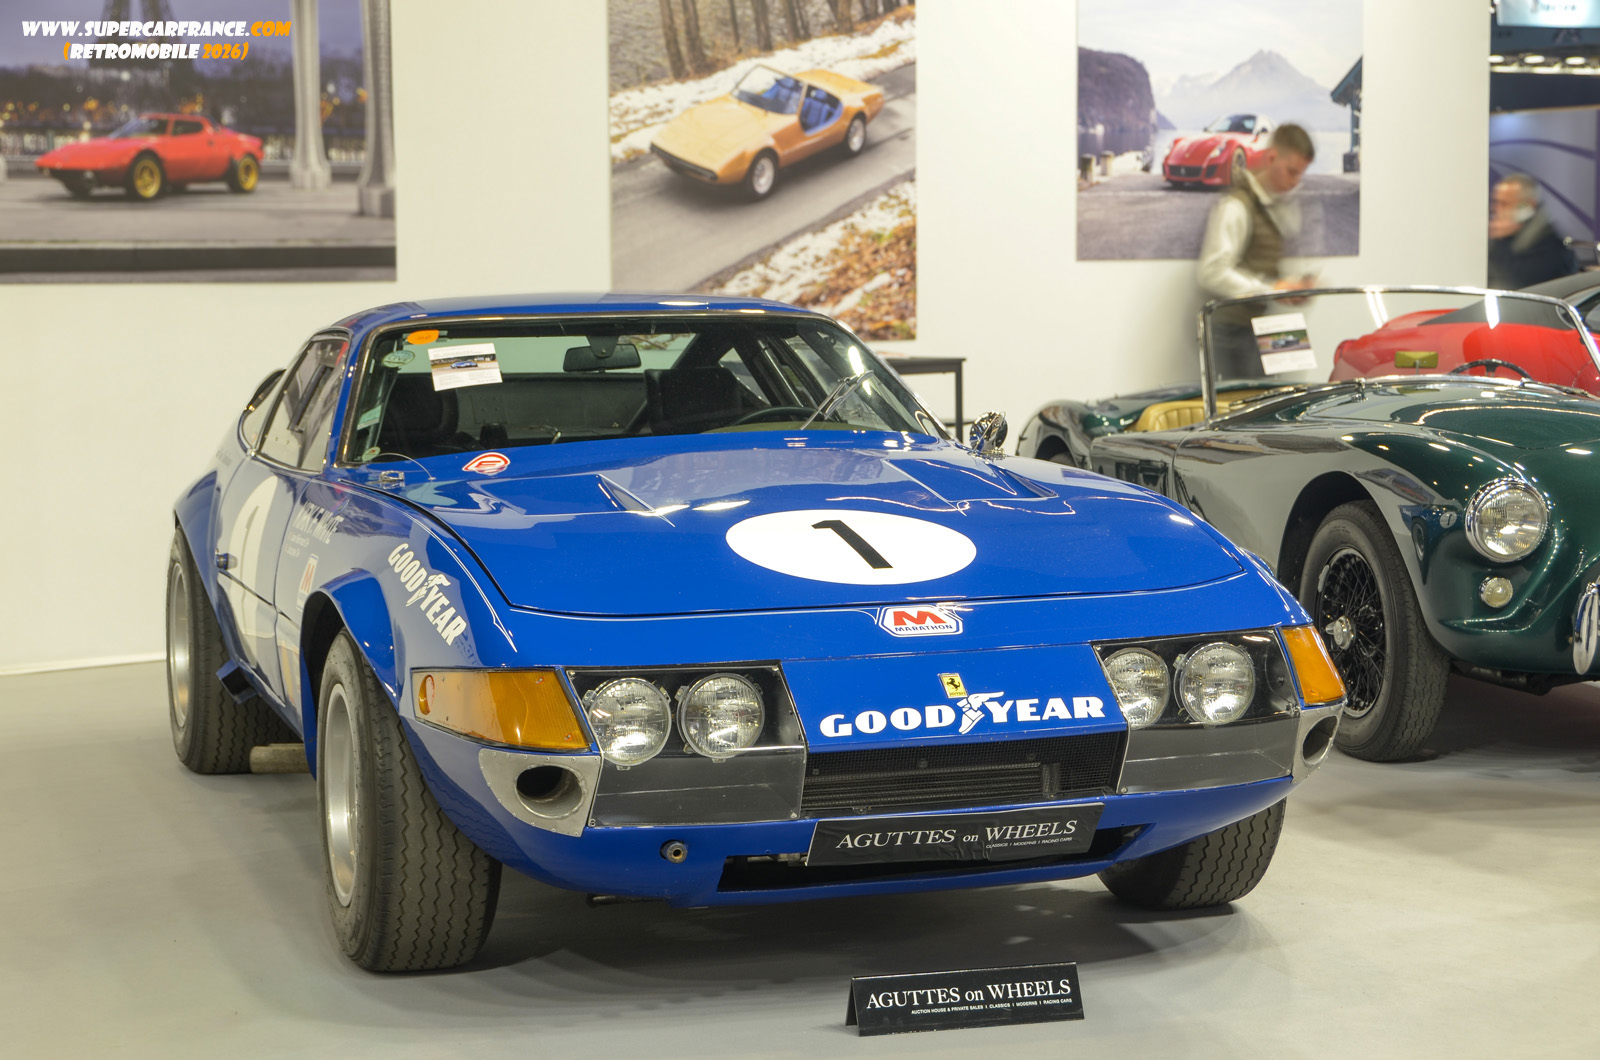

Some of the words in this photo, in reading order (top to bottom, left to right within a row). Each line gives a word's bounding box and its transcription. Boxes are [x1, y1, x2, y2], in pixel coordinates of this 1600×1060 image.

[811, 519, 894, 569] 1
[894, 624, 953, 632] MARATHON
[836, 829, 956, 849] AGUTTES
[962, 832, 979, 843] on
[985, 820, 1078, 841] WHEELS
[866, 987, 960, 1009] AGUTTES
[965, 990, 985, 1002] on
[986, 978, 1072, 1000] WHEELS
